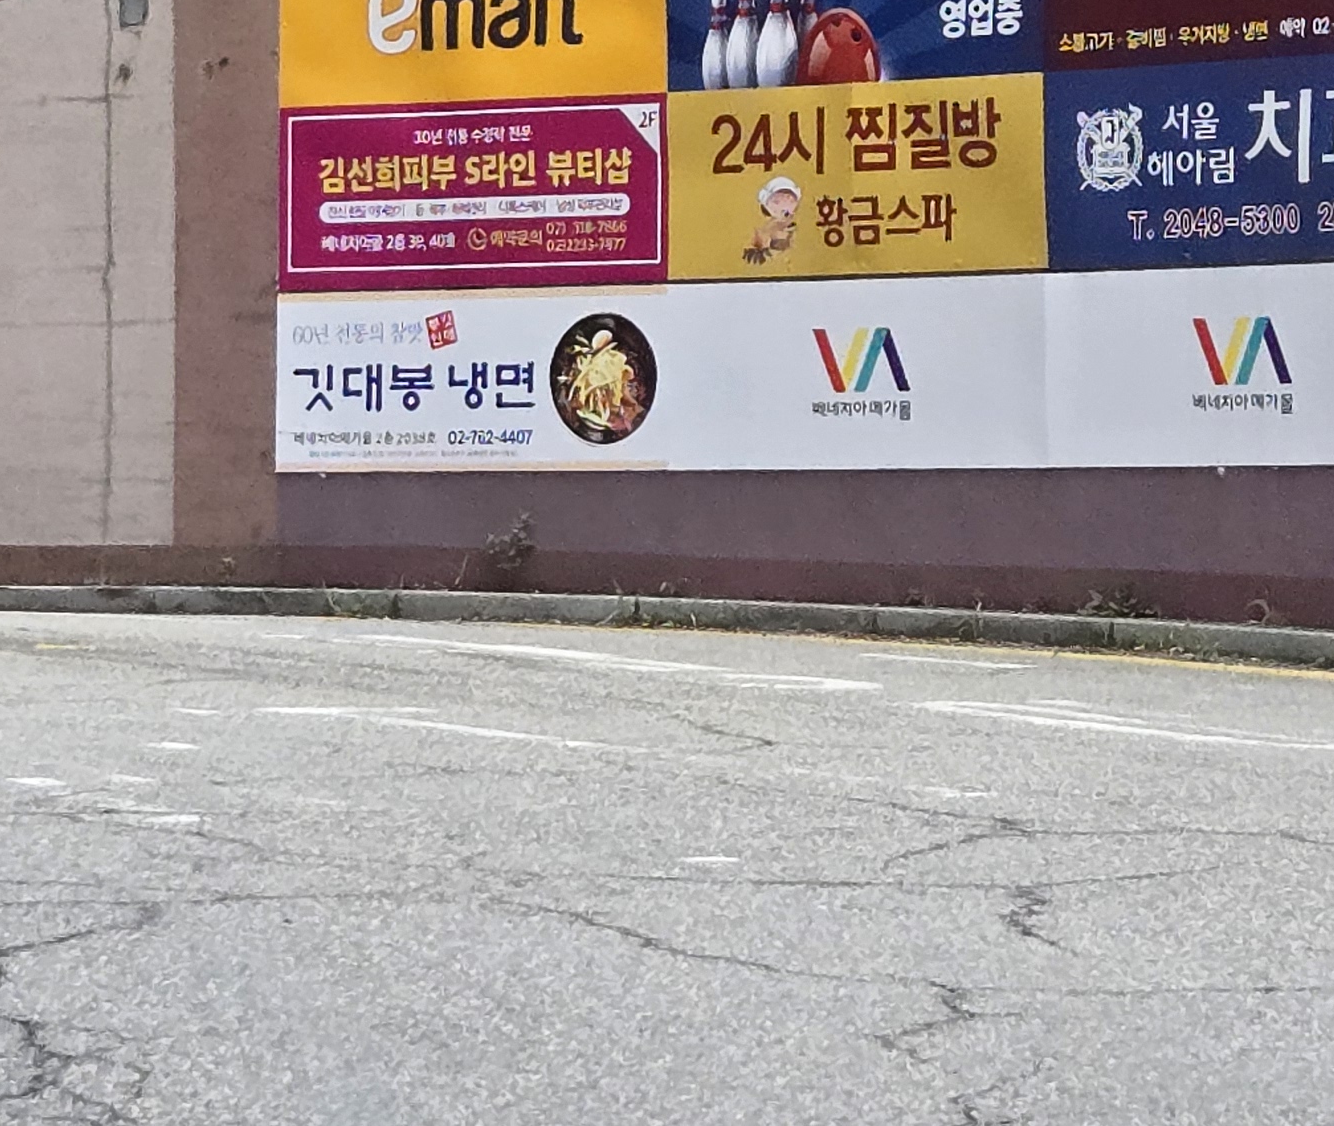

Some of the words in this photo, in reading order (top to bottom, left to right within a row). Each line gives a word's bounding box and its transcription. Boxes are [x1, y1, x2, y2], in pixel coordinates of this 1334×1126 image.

[638, 110, 659, 129] 2F
[711, 106, 826, 175] 24시
[844, 96, 1002, 173] 찜질방
[1161, 101, 1220, 141] 서울
[318, 154, 457, 194] 김선희피부
[463, 150, 537, 189] S라인
[545, 146, 634, 187] 뷰티샵
[815, 193, 958, 248] 황금스파
[292, 363, 435, 412] 깃대봉
[447, 360, 536, 410] 냉면
